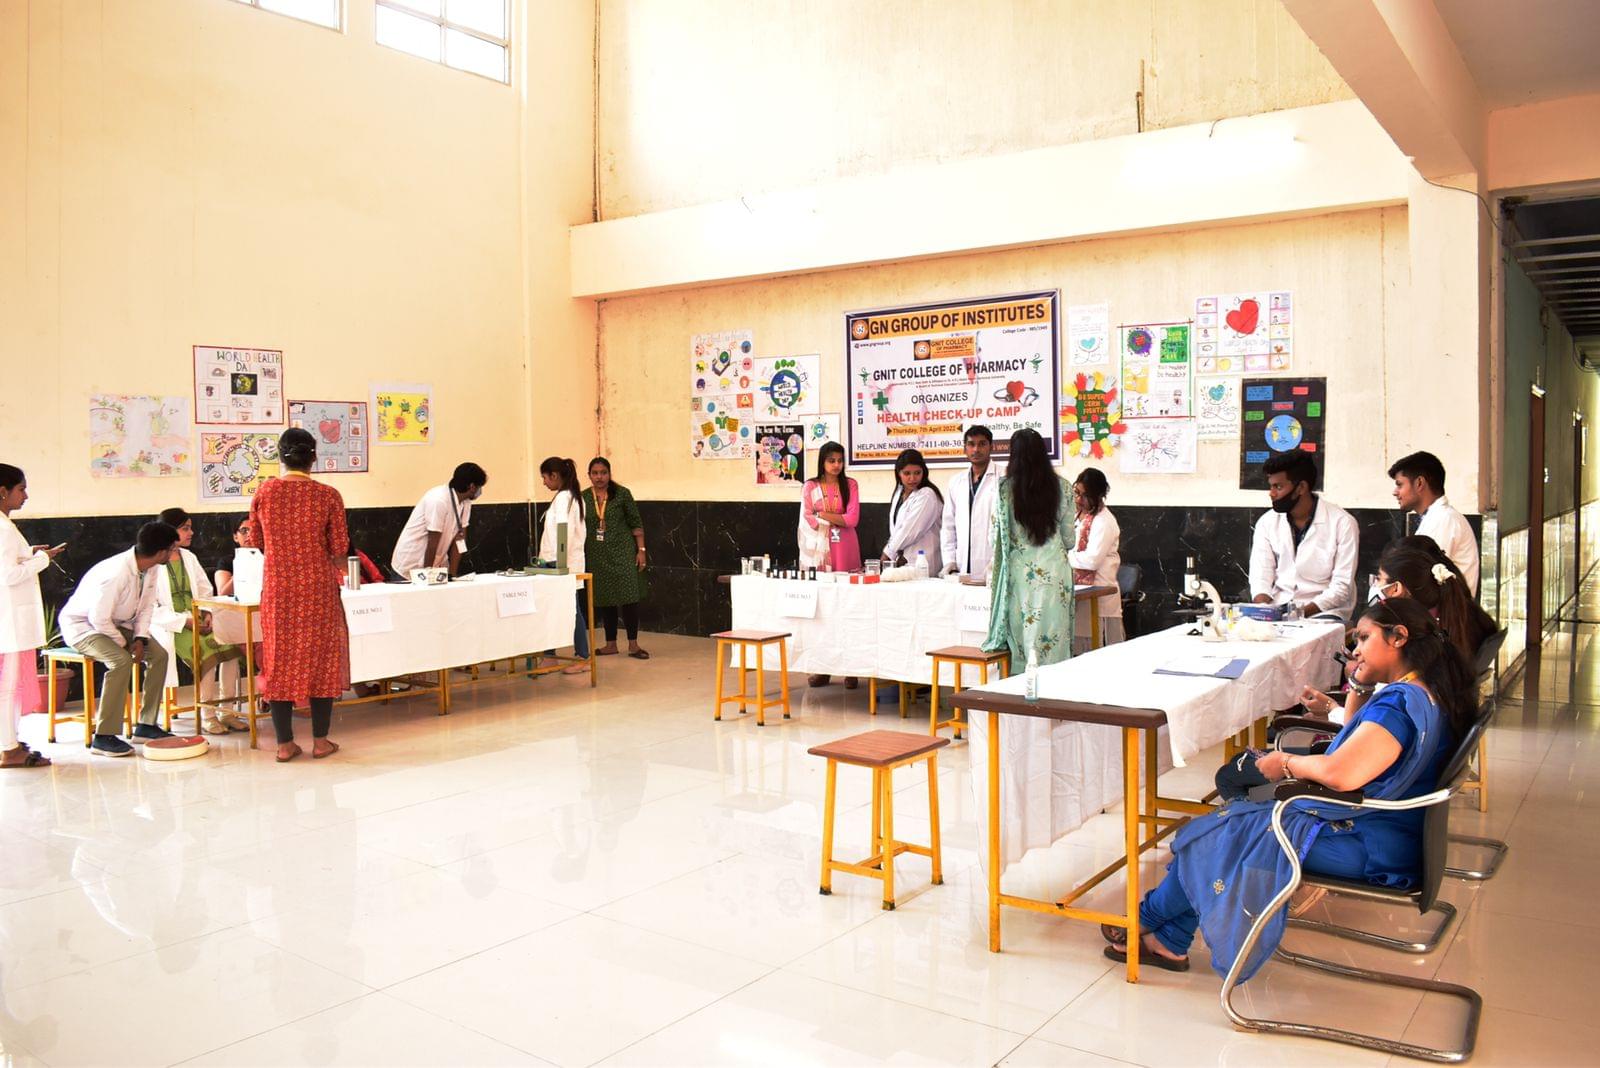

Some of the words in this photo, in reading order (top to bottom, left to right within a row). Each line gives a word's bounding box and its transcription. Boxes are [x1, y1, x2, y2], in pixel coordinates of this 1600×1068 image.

[870, 319, 889, 335] GN
[891, 313, 939, 333] GROUP
[941, 312, 959, 328] OF
[962, 303, 1045, 326] INSTITUTES
[946, 338, 974, 346] COLLEGE
[217, 350, 251, 362] WORLD
[253, 353, 280, 363] HEALTH
[873, 368, 897, 381] GNIT
[899, 364, 946, 379] COLLEGE
[950, 362, 962, 376] OF
[966, 358, 1027, 375] PHARMACY
[911, 392, 968, 404] ORGANIZES
[877, 411, 920, 424] HEALTH
[924, 408, 982, 421] CHECK-UP
[986, 406, 1020, 418] CAMP
[1025, 421, 1042, 429] Safe
[888, 441, 916, 450] NUMBER
